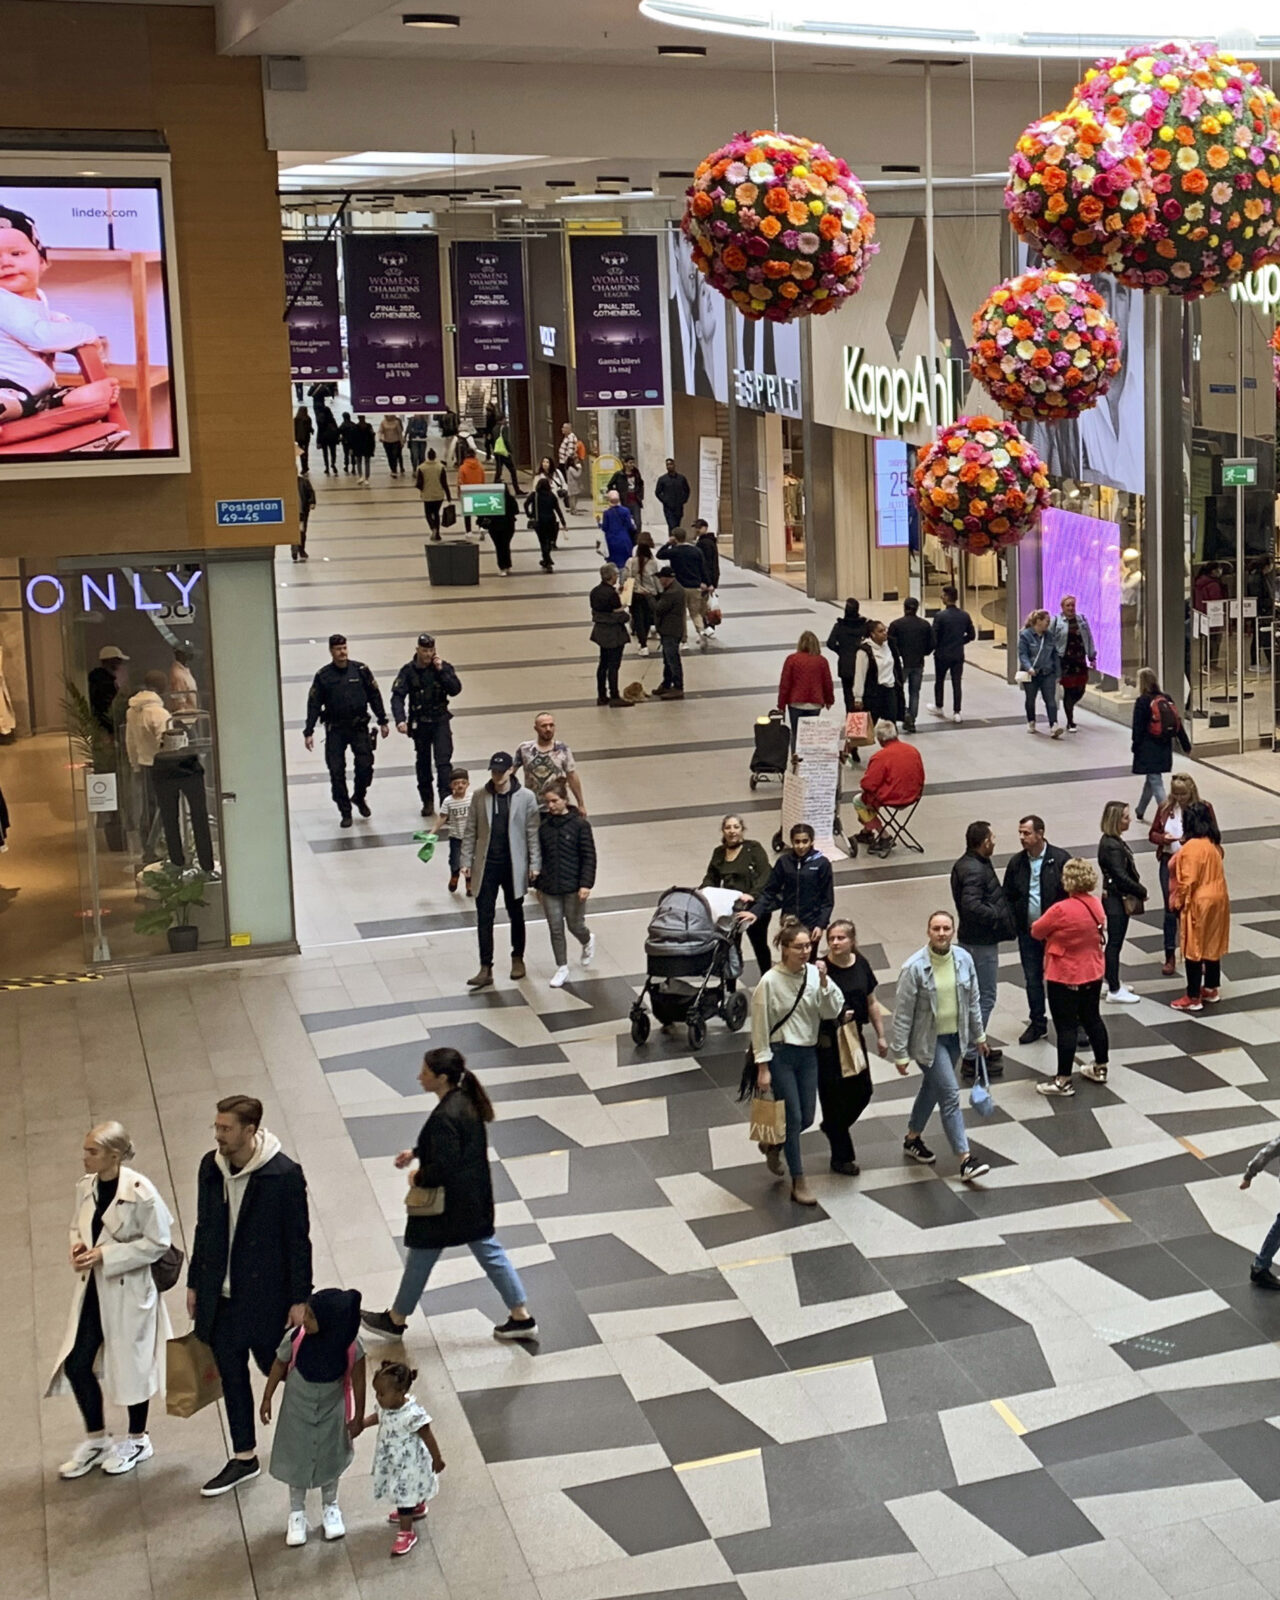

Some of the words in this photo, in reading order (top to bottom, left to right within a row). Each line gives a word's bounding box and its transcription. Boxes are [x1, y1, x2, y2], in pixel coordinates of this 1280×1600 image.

[72, 207, 138, 218] lindex.com
[733, 368, 799, 412] ESPRIT
[221, 502, 279, 513] Postgatan
[26, 570, 203, 615] ONLY
